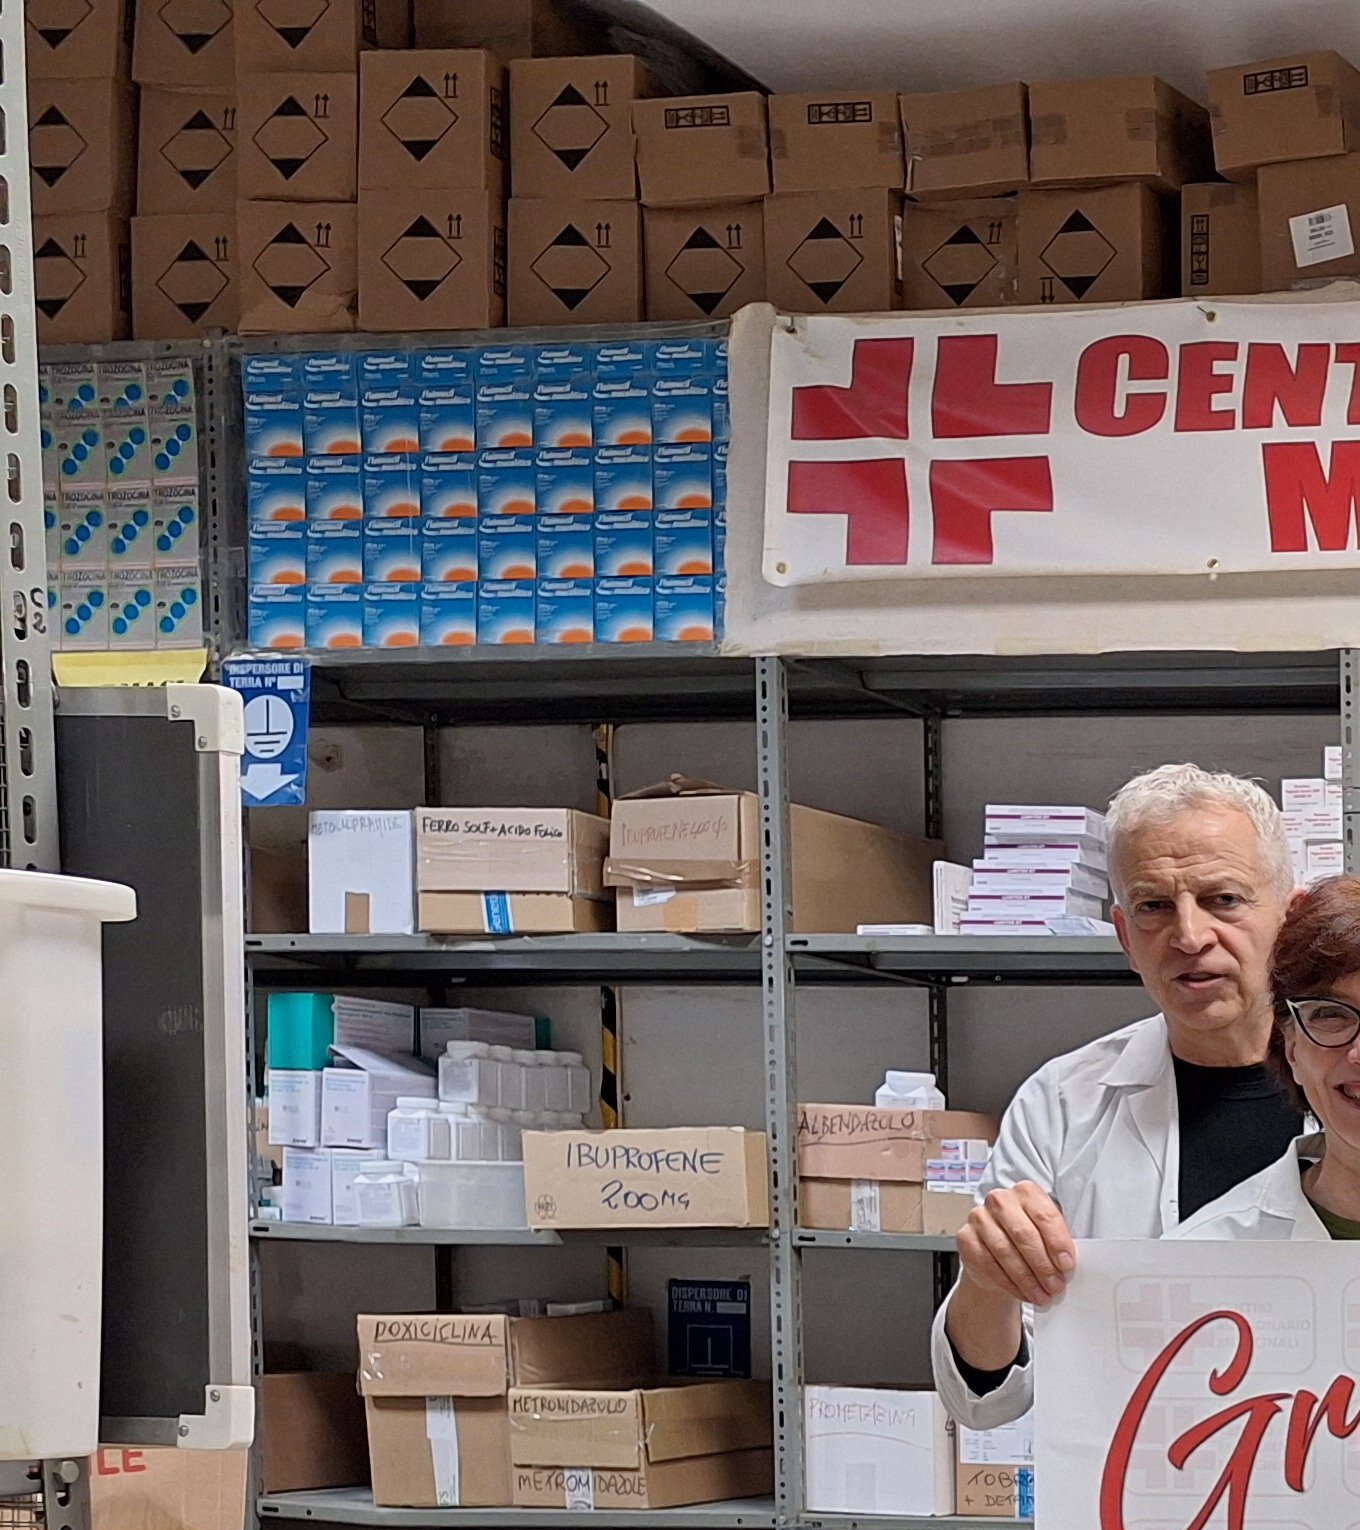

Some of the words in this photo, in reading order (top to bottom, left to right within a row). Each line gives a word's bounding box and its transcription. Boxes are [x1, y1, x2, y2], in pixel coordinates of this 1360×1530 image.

[294, 660, 303, 672] DI
[229, 676, 262, 688] TERRA
[422, 817, 459, 834] FERRO
[565, 1141, 724, 1177] IBUPROFENE
[671, 1285, 731, 1302] DISPERSORE
[734, 1285, 749, 1302] DI
[671, 1299, 702, 1313] TERRA
